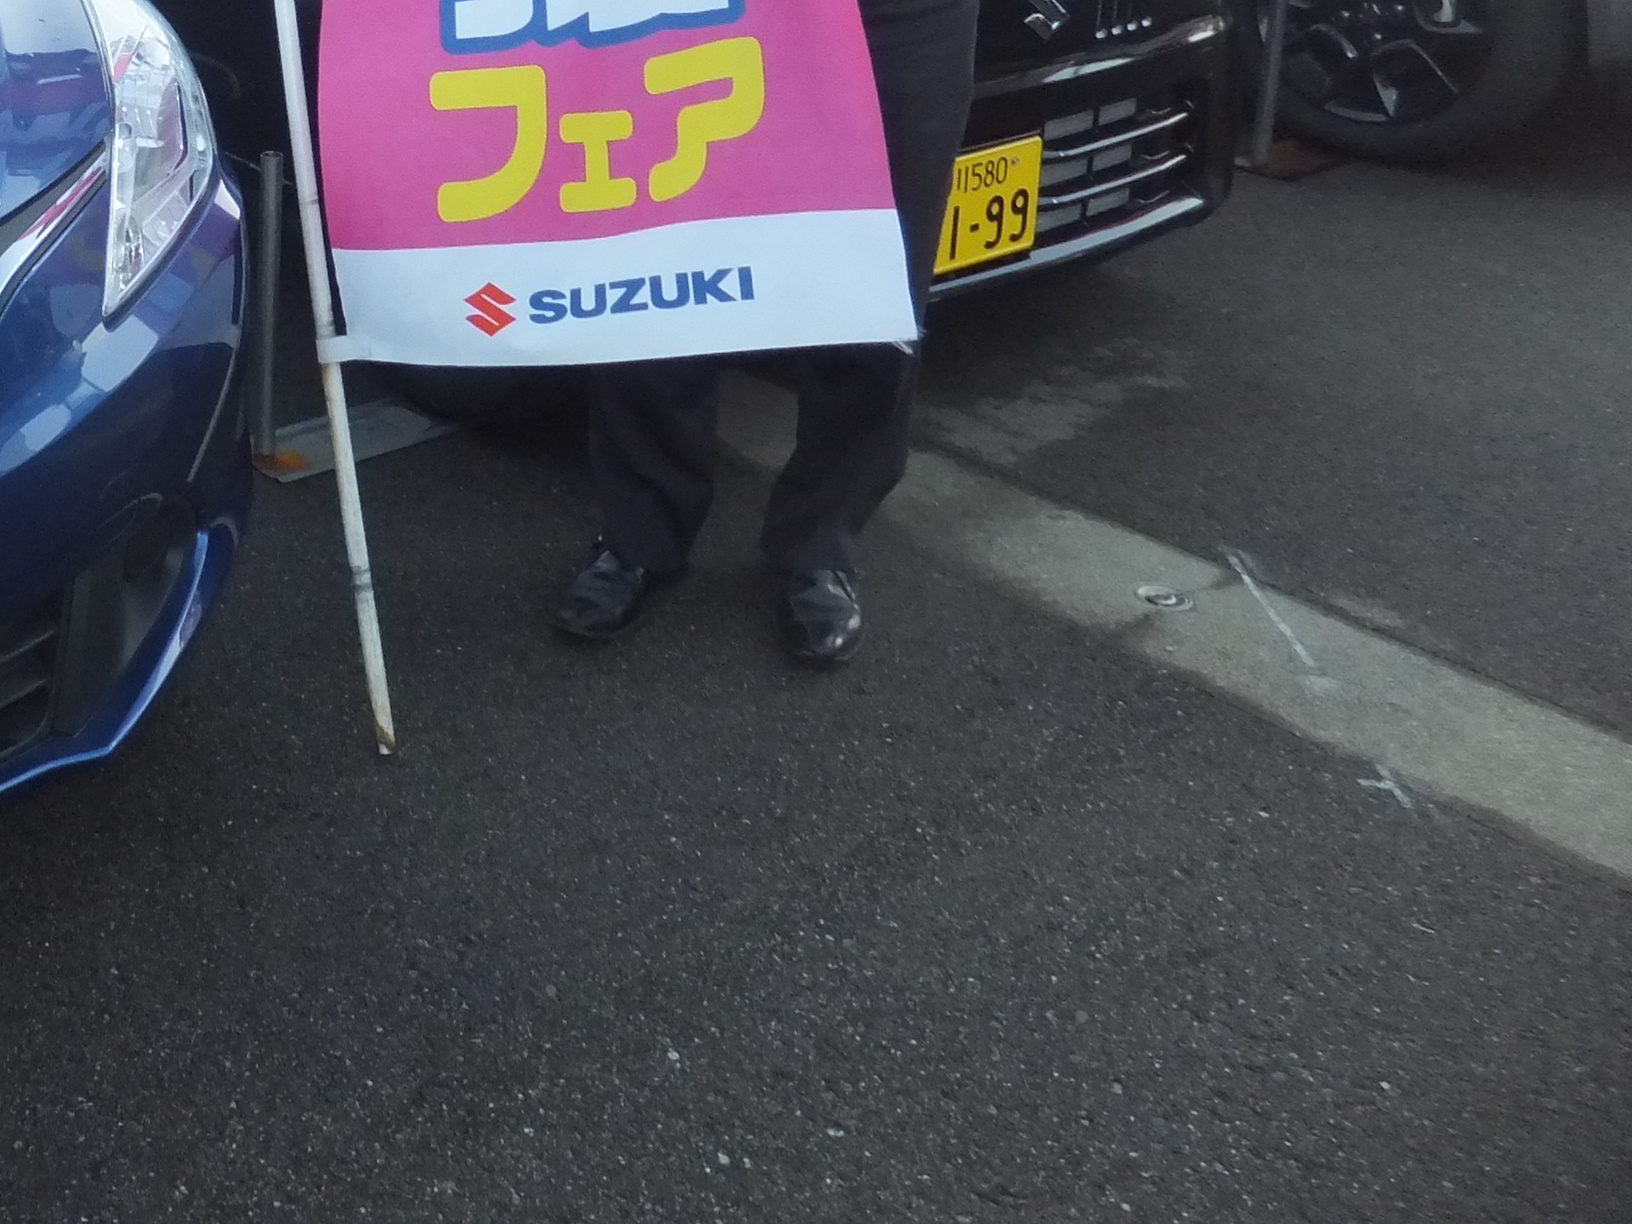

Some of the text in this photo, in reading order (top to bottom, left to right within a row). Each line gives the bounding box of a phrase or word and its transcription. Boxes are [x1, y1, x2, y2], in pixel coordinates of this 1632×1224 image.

[429, 36, 765, 223] フェア
[528, 265, 756, 325] SUZUKI
